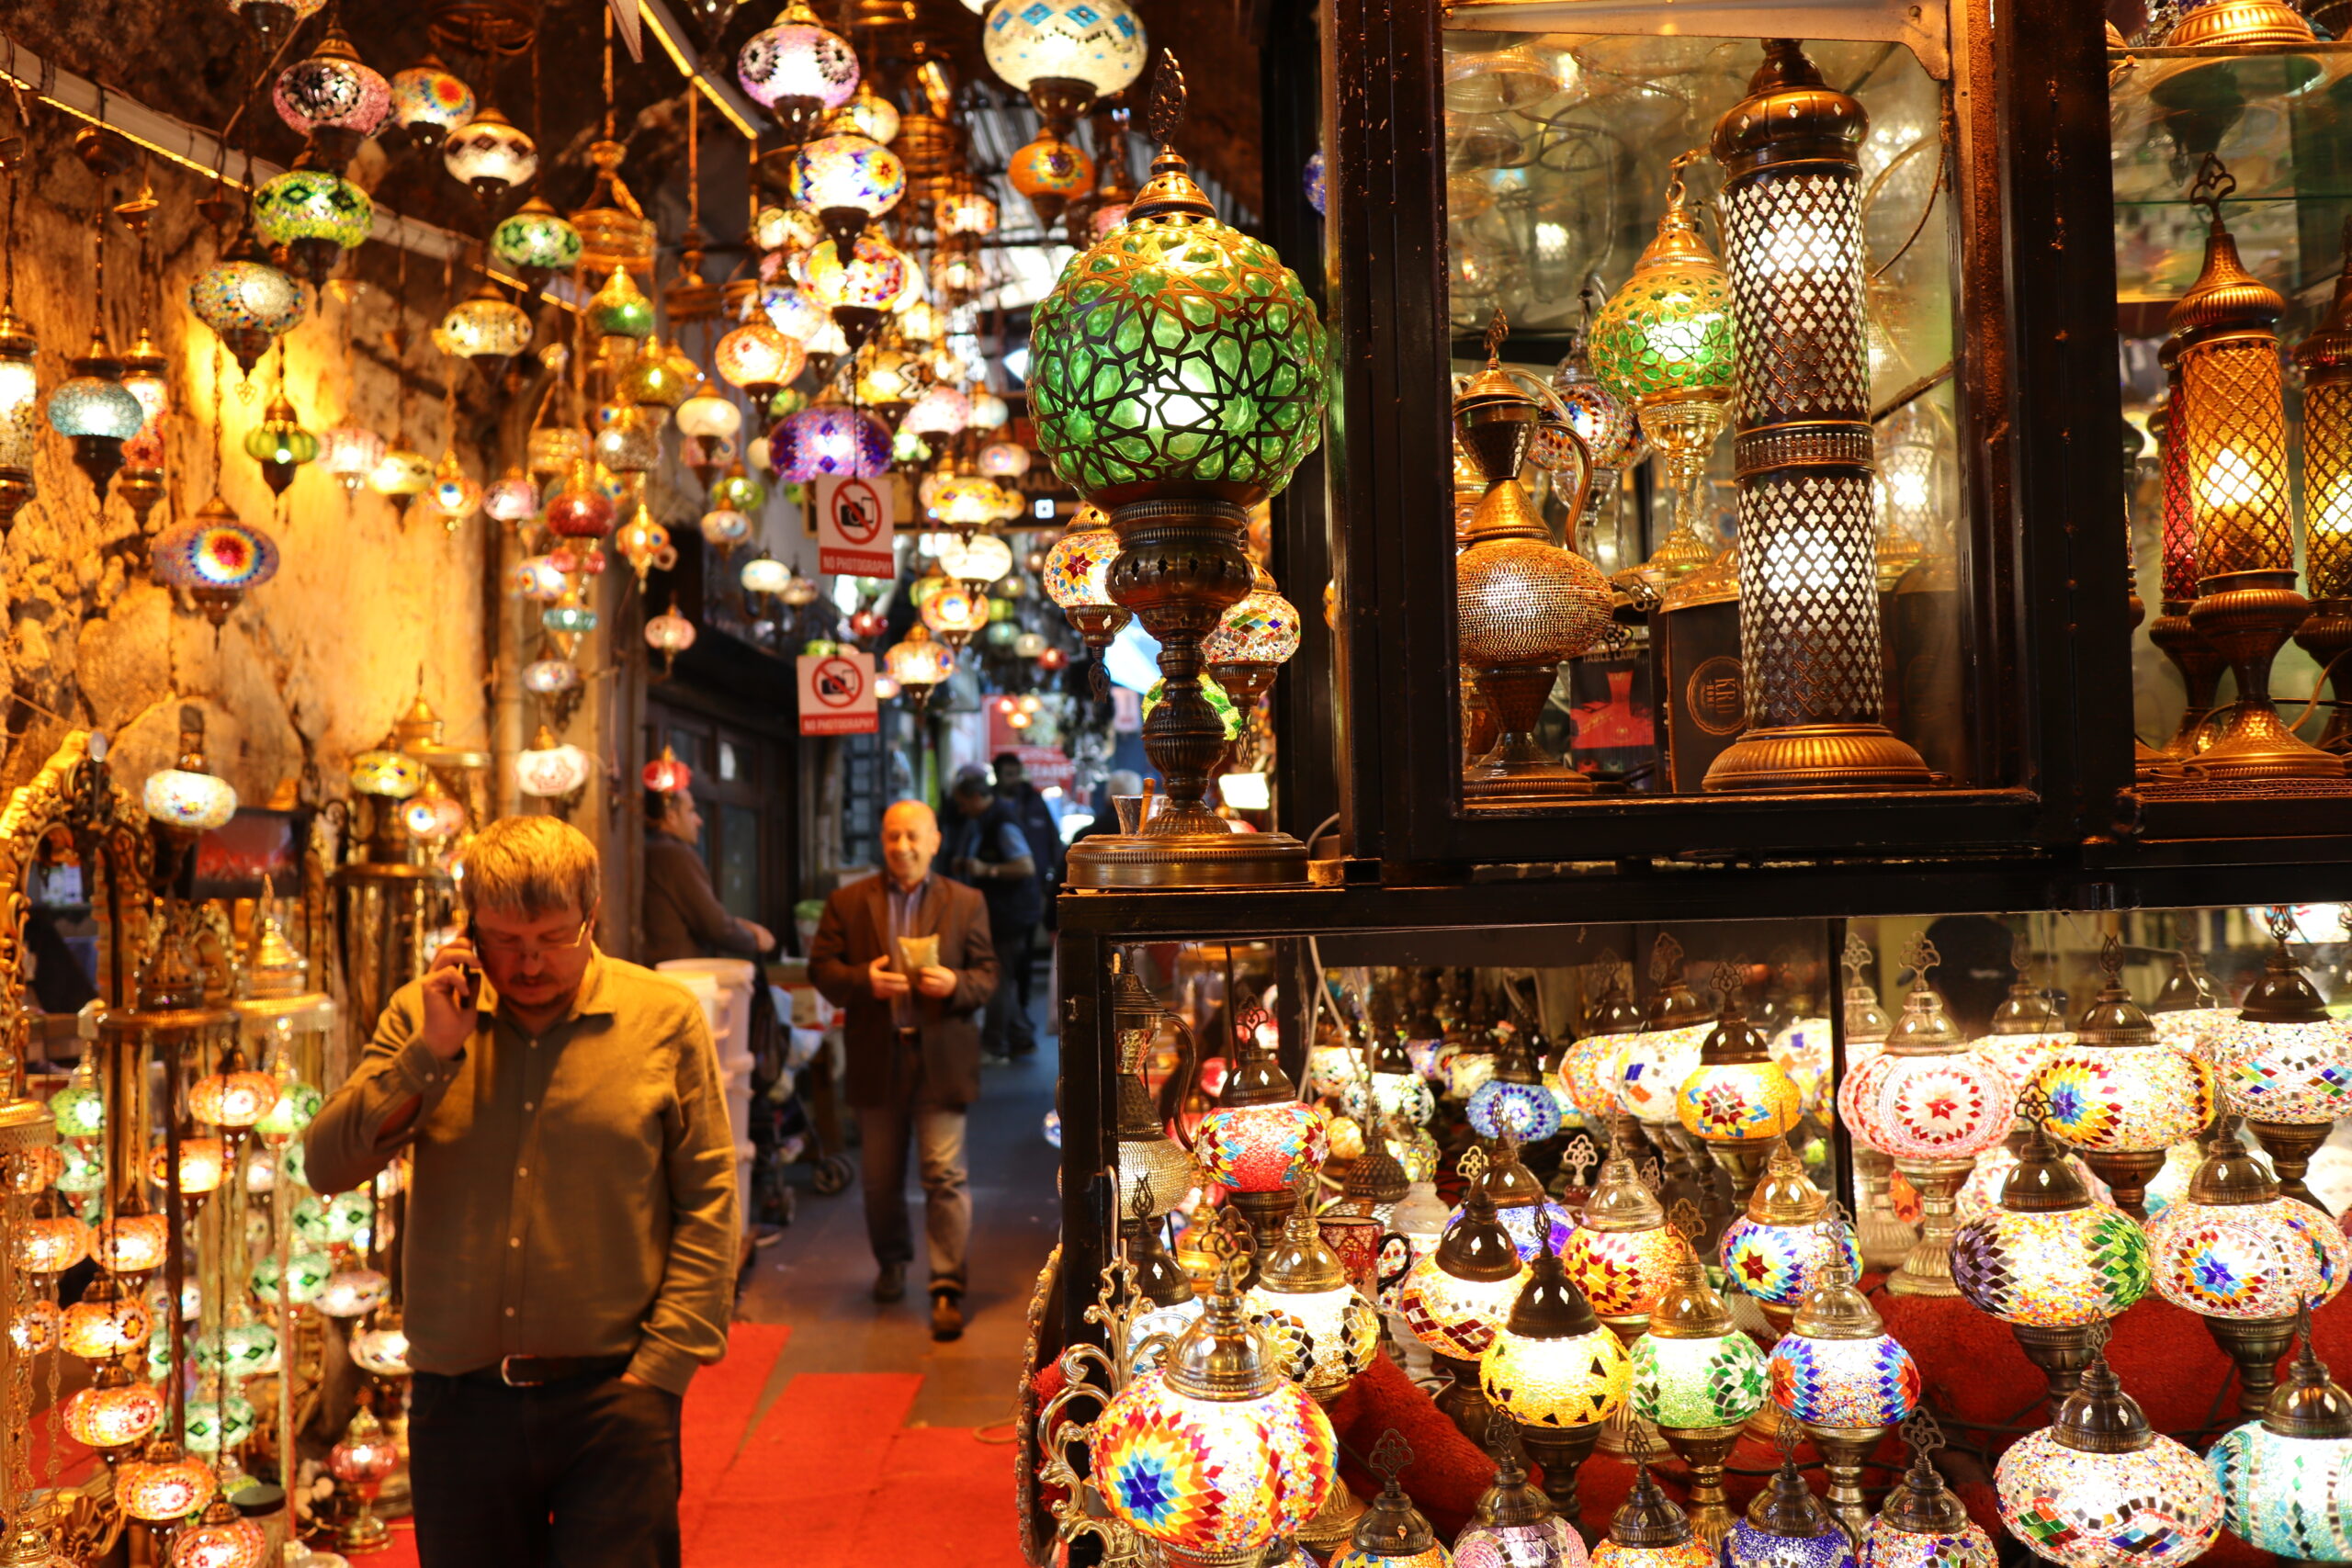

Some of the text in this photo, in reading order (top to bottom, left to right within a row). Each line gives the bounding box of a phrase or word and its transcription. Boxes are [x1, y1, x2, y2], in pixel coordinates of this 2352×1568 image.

[823, 556, 892, 574] NO PHOTOGRAPHY
[1583, 649, 1640, 662] TABLE LAMP
[804, 717, 874, 732] NO PHOTOGRAPHY
